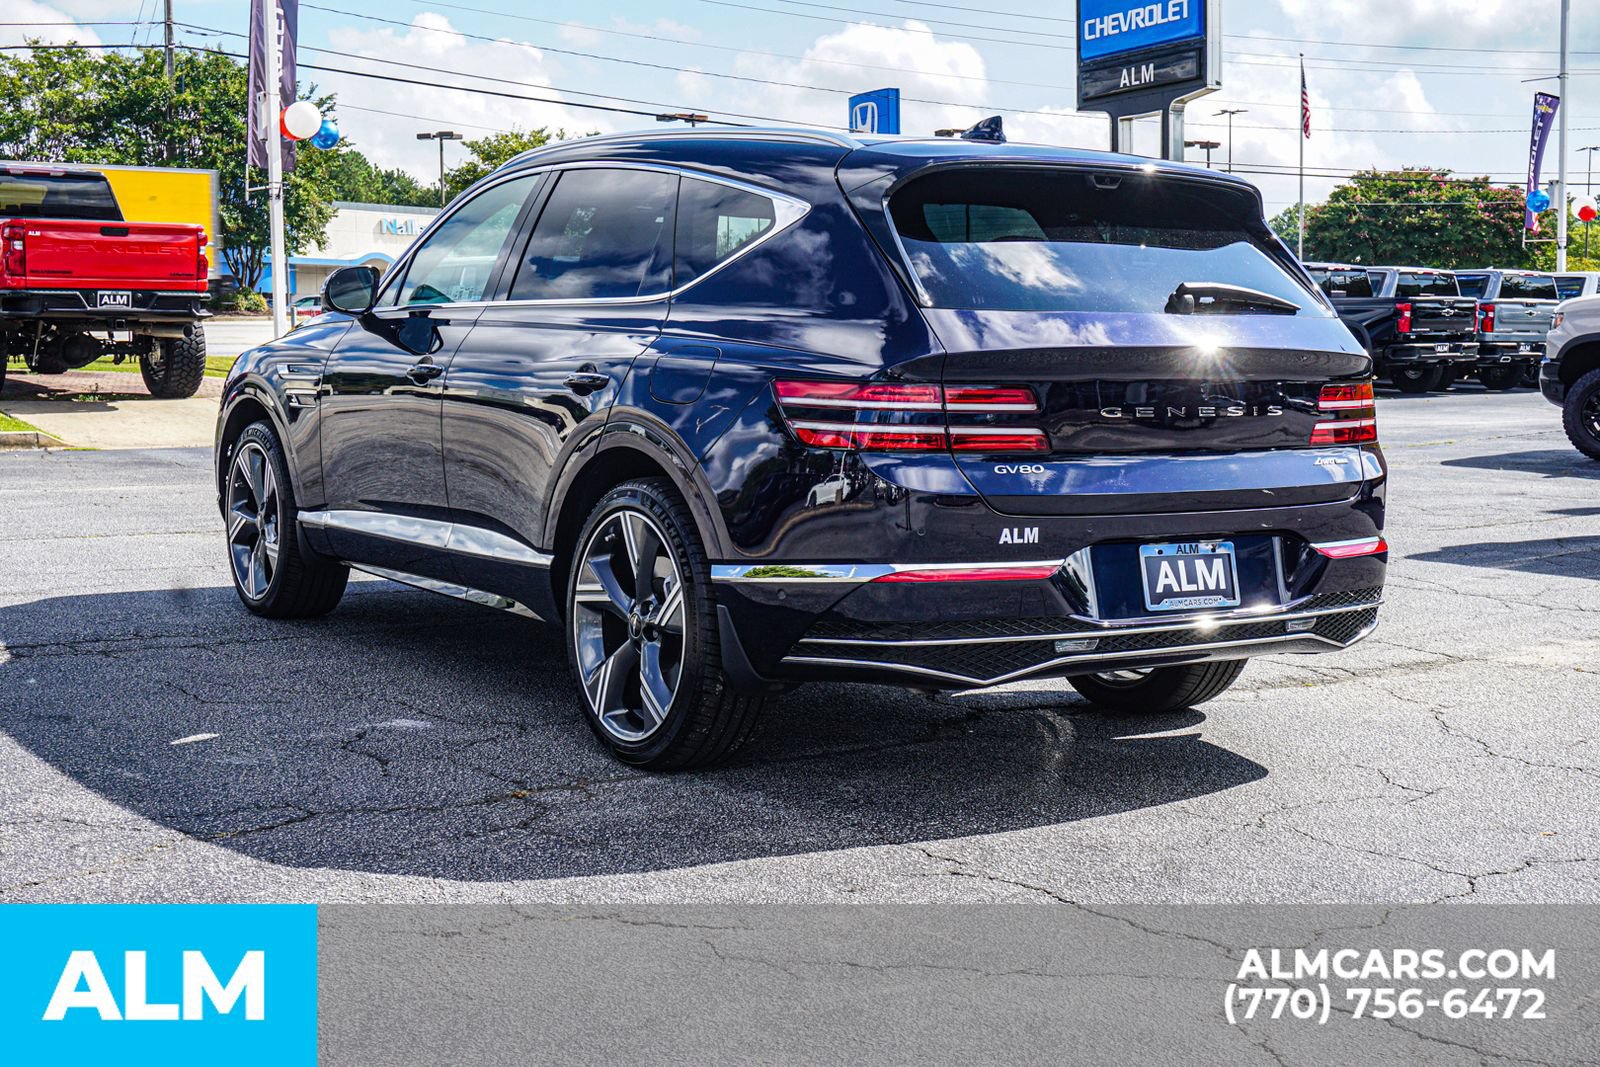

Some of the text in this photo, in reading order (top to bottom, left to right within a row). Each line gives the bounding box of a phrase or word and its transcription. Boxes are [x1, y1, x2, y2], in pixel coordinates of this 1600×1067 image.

[1084, 0, 1189, 40] CHEVROLET
[1120, 63, 1154, 88] ALM
[101, 295, 128, 304] ALM
[1100, 405, 1283, 418] GENESIS
[994, 464, 1045, 474] GV80
[999, 527, 1039, 544] ALM
[1176, 544, 1199, 554] ALM
[1156, 558, 1227, 593] ALM
